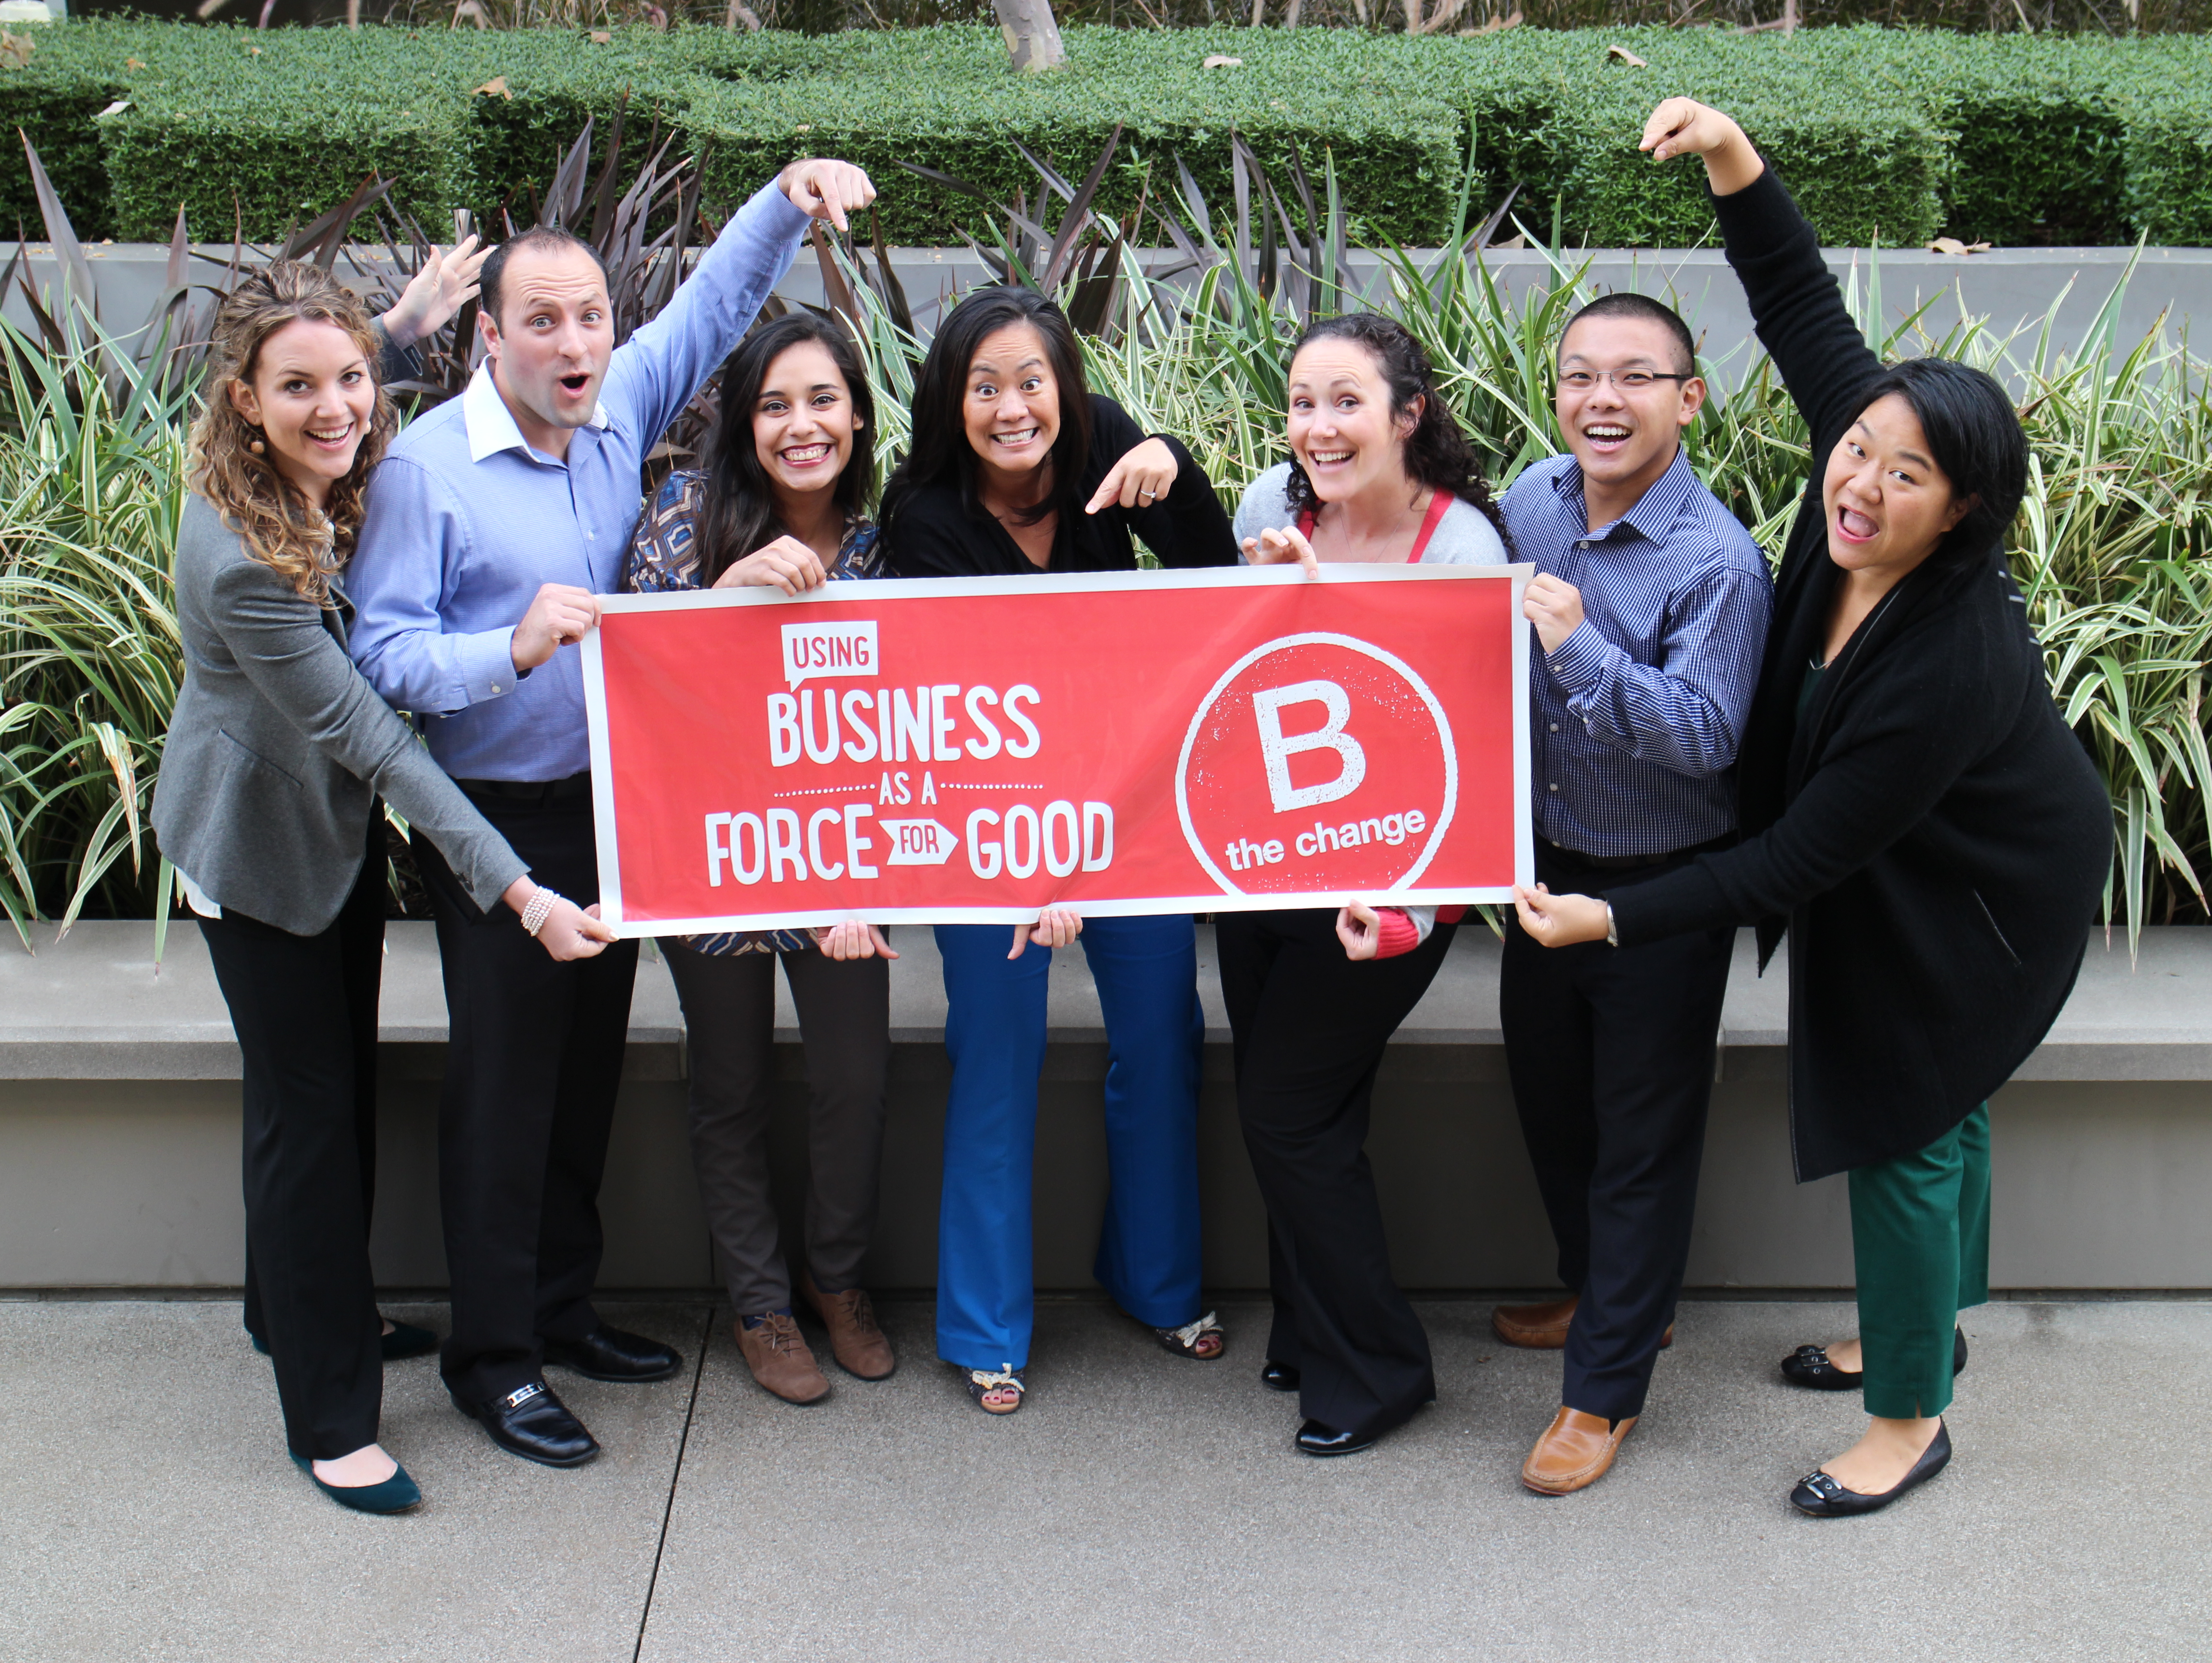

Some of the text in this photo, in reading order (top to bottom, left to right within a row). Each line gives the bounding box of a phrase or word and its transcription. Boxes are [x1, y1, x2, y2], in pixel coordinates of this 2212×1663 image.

[792, 636, 870, 669] USING
[767, 683, 1041, 768] BUSINESS
[1252, 679, 1367, 814] B
[878, 771, 938, 806] AS A
[704, 799, 1114, 887] FORCE FOR GOOD
[1225, 810, 1426, 871] the change
